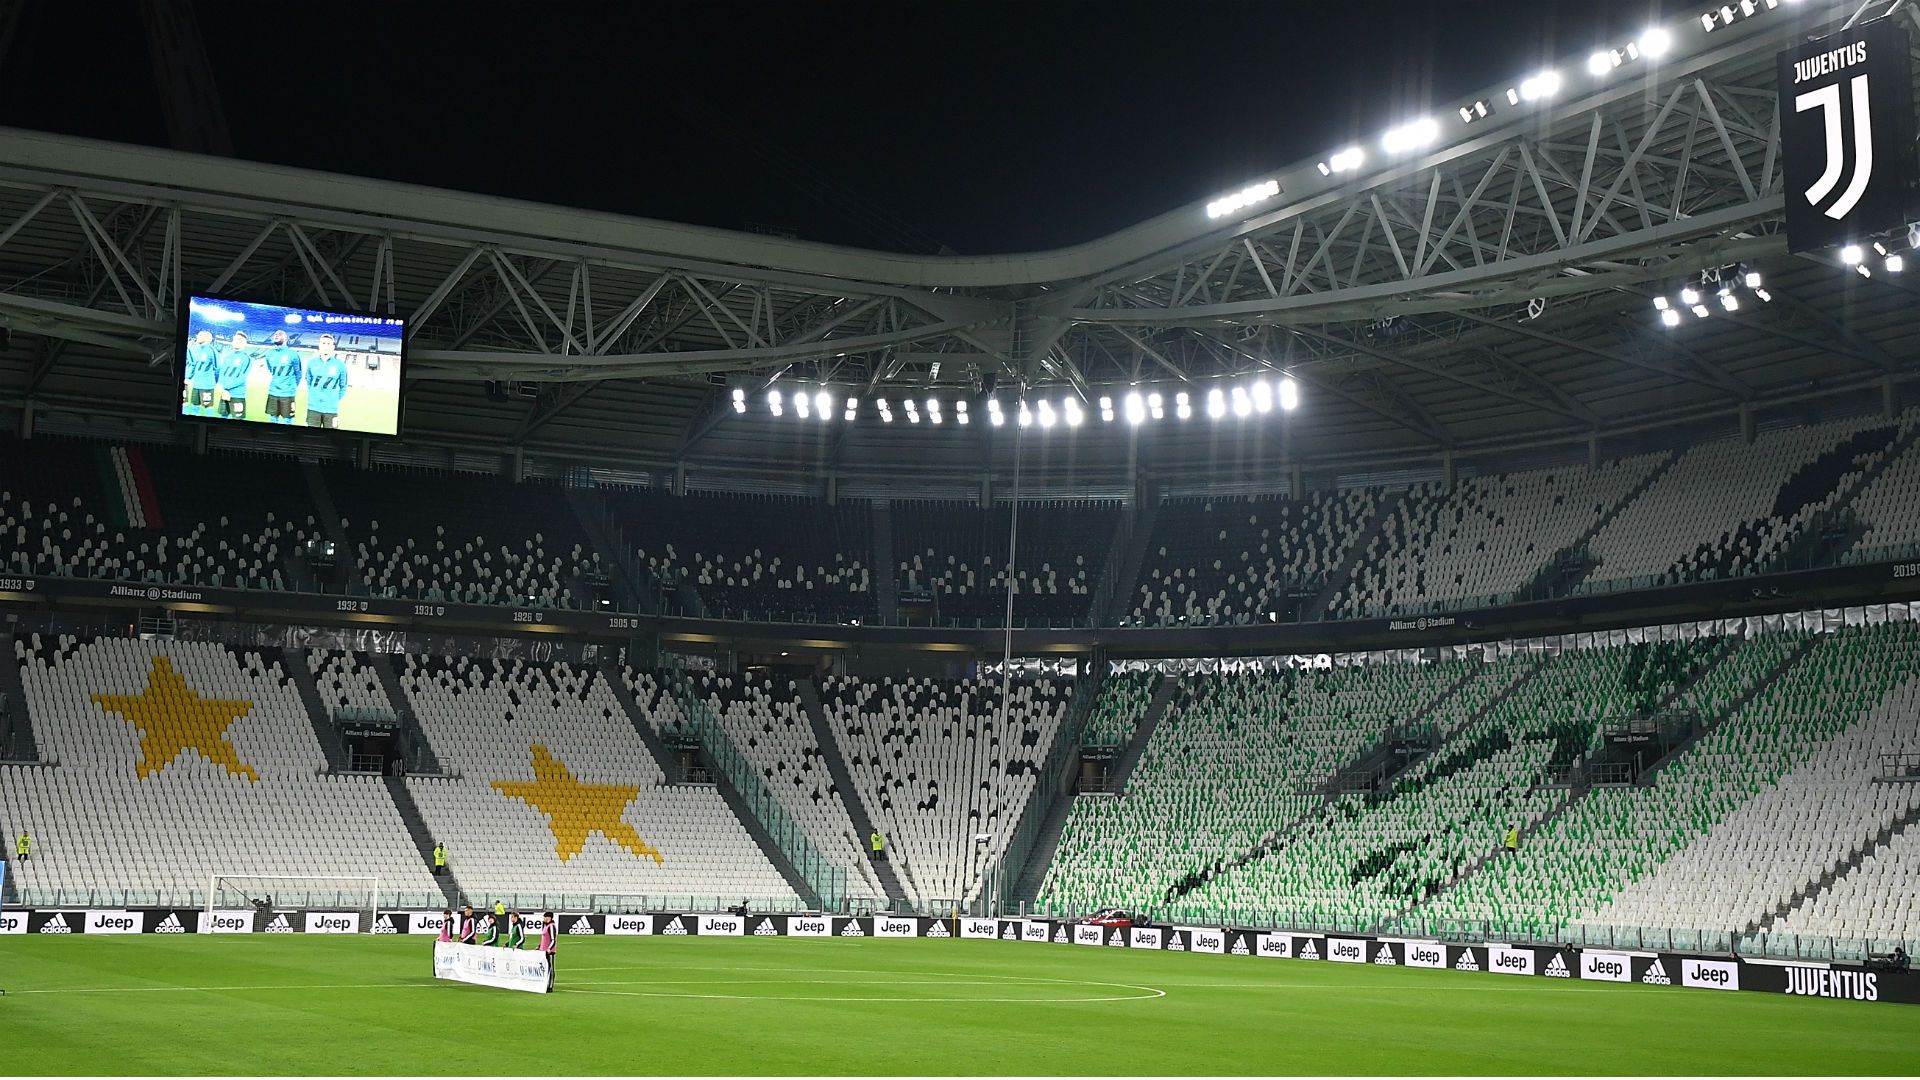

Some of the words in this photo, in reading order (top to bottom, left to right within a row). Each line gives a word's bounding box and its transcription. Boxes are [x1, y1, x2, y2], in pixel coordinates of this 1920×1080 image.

[1793, 40, 1867, 84] JUVENTUS
[1893, 563, 1916, 577] 2019
[0, 579, 22, 590] 1933
[110, 585, 146, 598] Allianz
[161, 588, 202, 600] Stadium
[336, 600, 357, 611] 1932
[414, 605, 434, 616] 1931
[609, 617, 628, 628] 1905
[1389, 620, 1416, 631] Allianz
[1427, 616, 1455, 627] Stadium
[0, 915, 18, 931] ep
[40, 923, 72, 934] adidas
[95, 915, 134, 931] Jeep
[155, 923, 186, 934] adidas
[314, 915, 351, 931] Jeep
[418, 916, 444, 930] Jee
[613, 917, 645, 932] Jeep
[705, 918, 737, 933] Jeep
[795, 919, 825, 934] Jeep
[881, 920, 910, 935] Jeep
[968, 922, 994, 937] Jeep
[1026, 924, 1045, 940] Jeep
[1078, 926, 1099, 943] Jeep
[1135, 929, 1157, 946] Jeep
[1197, 934, 1219, 951] Jeep
[1262, 936, 1287, 955] Jeep
[1333, 940, 1360, 959] Jeep
[1411, 946, 1440, 966] Jeep
[1496, 951, 1527, 971] Jeep
[1455, 961, 1480, 972] adidas
[1544, 967, 1571, 978] adidas
[1588, 957, 1623, 978] Jeep
[1691, 963, 1729, 985] Jeep
[1642, 974, 1671, 986] adidas
[1785, 966, 1878, 1000] JUVENTUS
